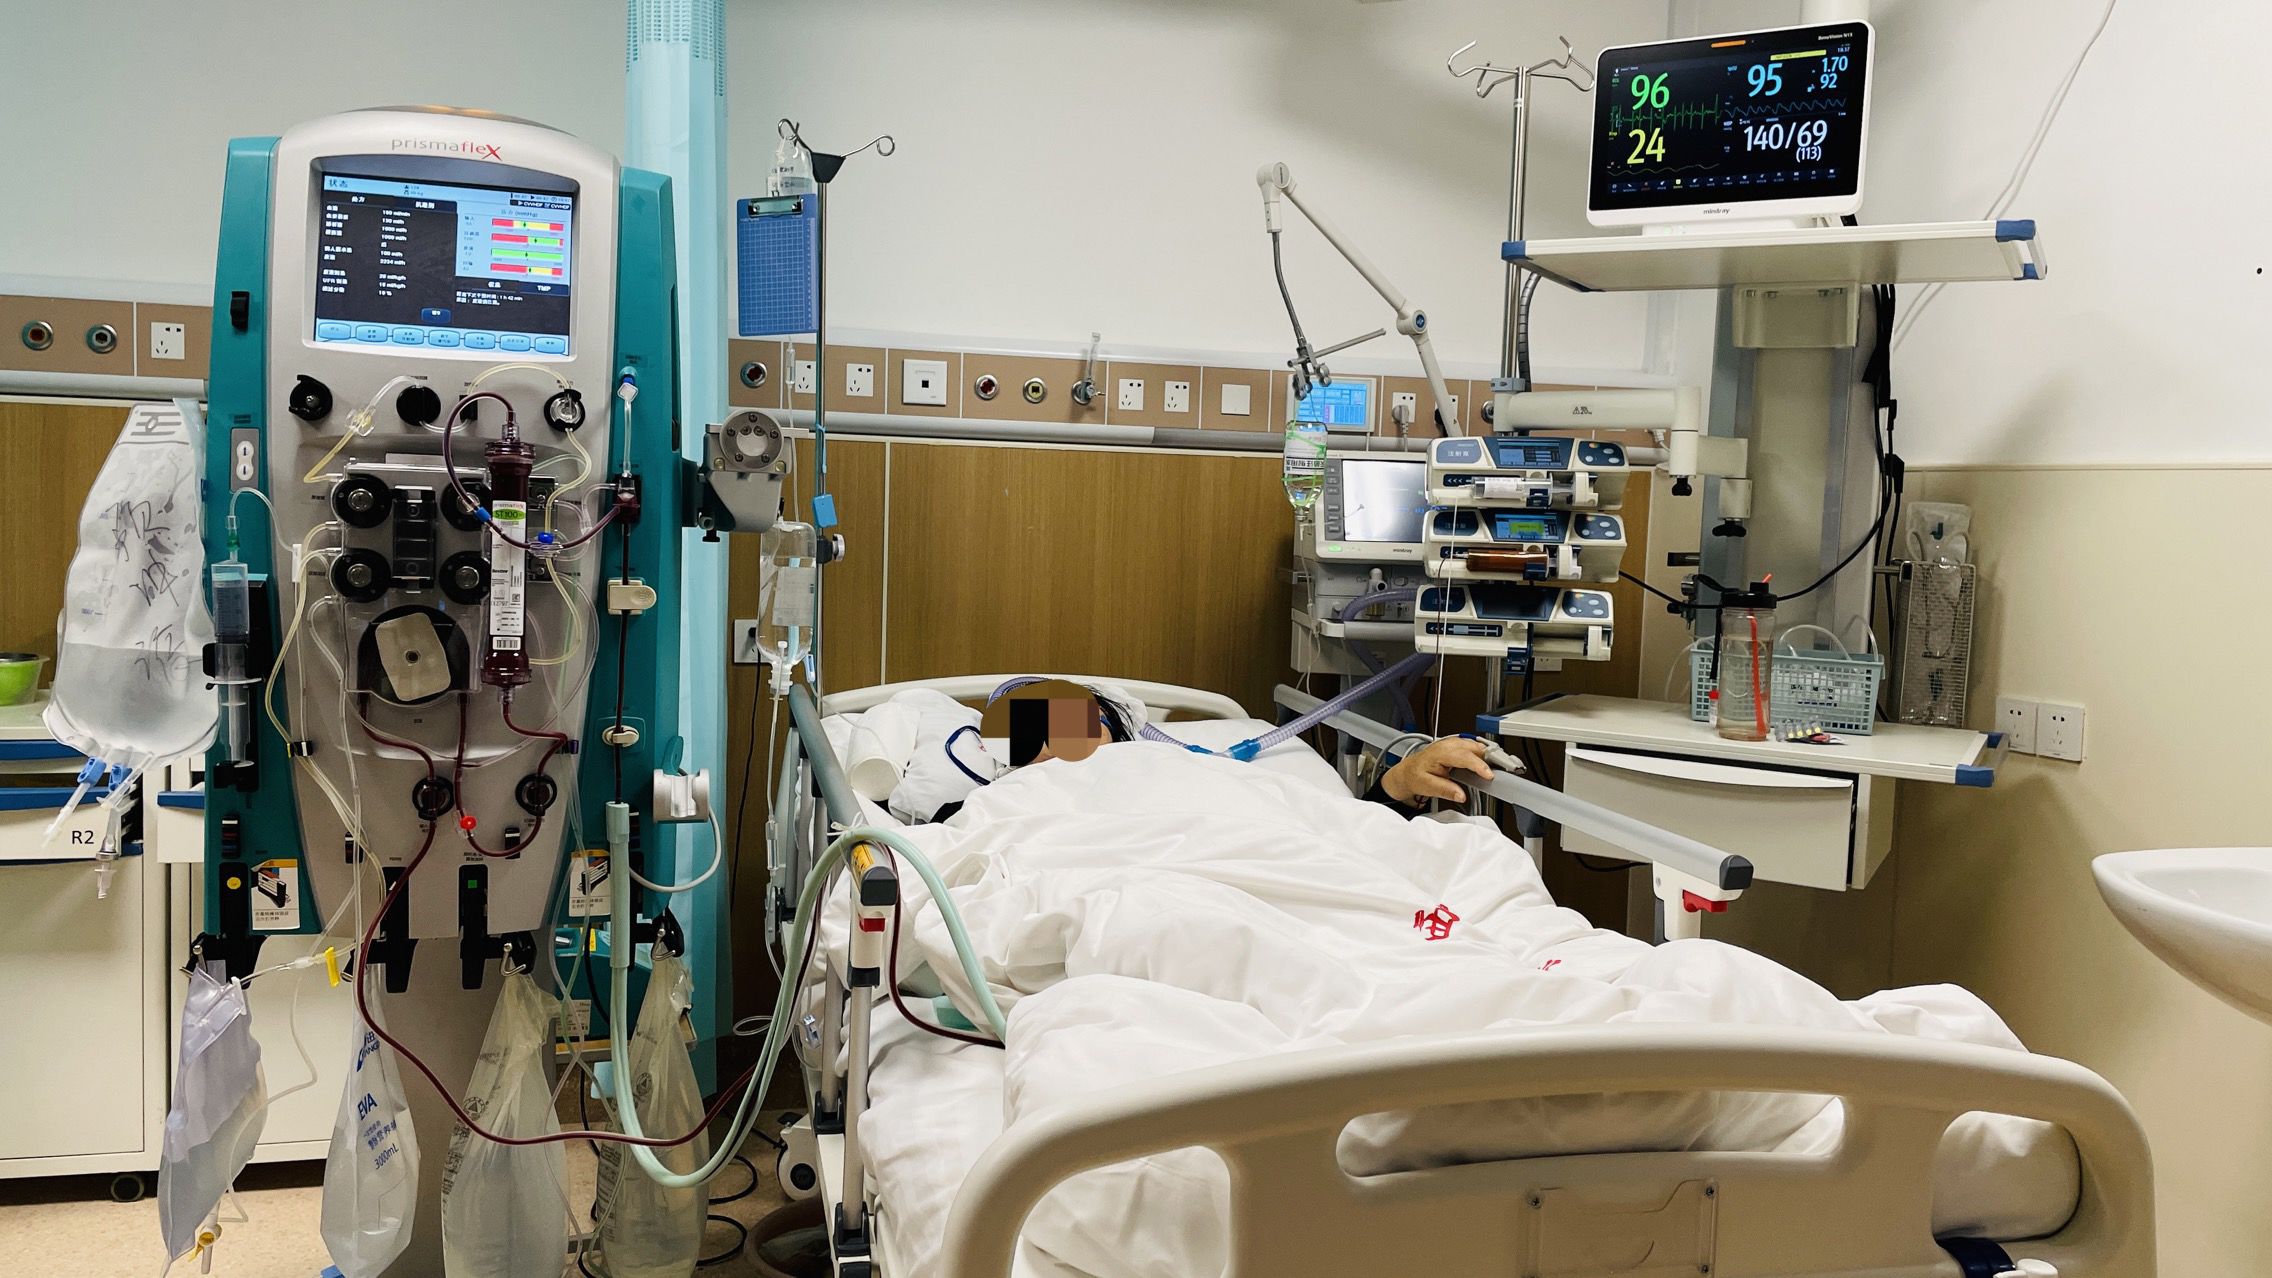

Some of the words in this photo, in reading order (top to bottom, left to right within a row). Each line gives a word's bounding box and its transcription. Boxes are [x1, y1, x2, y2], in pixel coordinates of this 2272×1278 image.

[1821, 55, 1848, 73] 1.70
[1631, 72, 1670, 111] 96
[1747, 63, 1783, 97] 95
[1820, 73, 1838, 89] 92
[1627, 127, 1666, 164] 24
[1743, 119, 1828, 152] 140/69
[1796, 145, 1822, 162] (113)
[1703, 207, 1730, 216] mindray
[71, 830, 95, 845] R2
[358, 1092, 378, 1120] EVA
[374, 1143, 399, 1170] 3000mL
